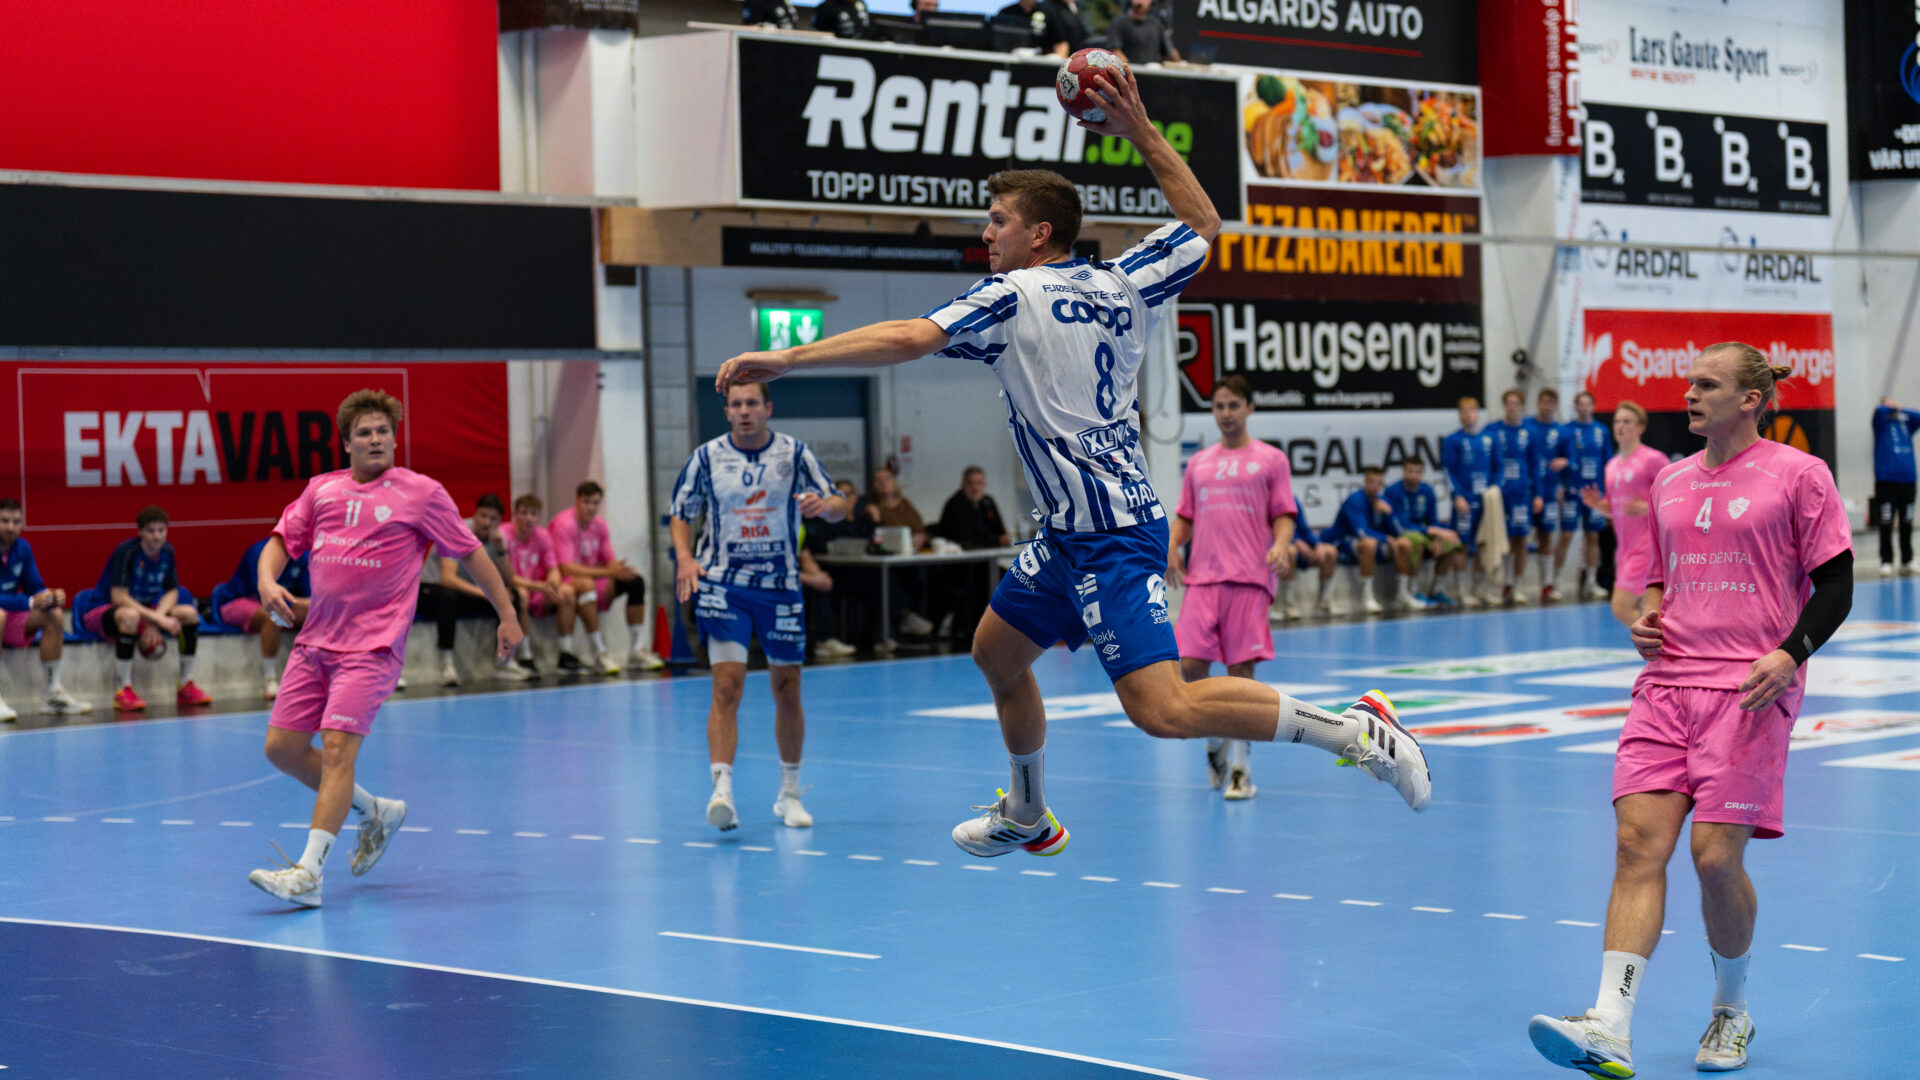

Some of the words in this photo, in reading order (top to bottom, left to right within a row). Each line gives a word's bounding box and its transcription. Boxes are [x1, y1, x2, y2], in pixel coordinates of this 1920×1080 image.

[1345, 3, 1423, 40] AUTO
[1628, 26, 1666, 65] Lars
[1670, 30, 1719, 72] Gaute
[1723, 37, 1769, 82] Sport
[806, 170, 875, 200] TOPP
[879, 174, 974, 205] UTSTYR
[1051, 298, 1133, 337] coop
[1222, 303, 1444, 388] Haugseng
[1770, 340, 1834, 386] Norge
[1094, 341, 1117, 420] 8
[64, 410, 350, 488] EKTAVAR
[741, 463, 767, 488] 67
[1215, 460, 1239, 481] 24
[344, 499, 363, 527] 11
[1694, 496, 1713, 534] 4
[740, 526, 770, 539] RISA
[1681, 552, 1707, 565] ORIS
[1709, 551, 1755, 566] DENTAL
[1724, 801, 1754, 812] CRAFT
[1622, 963, 1636, 990] CRAFT
